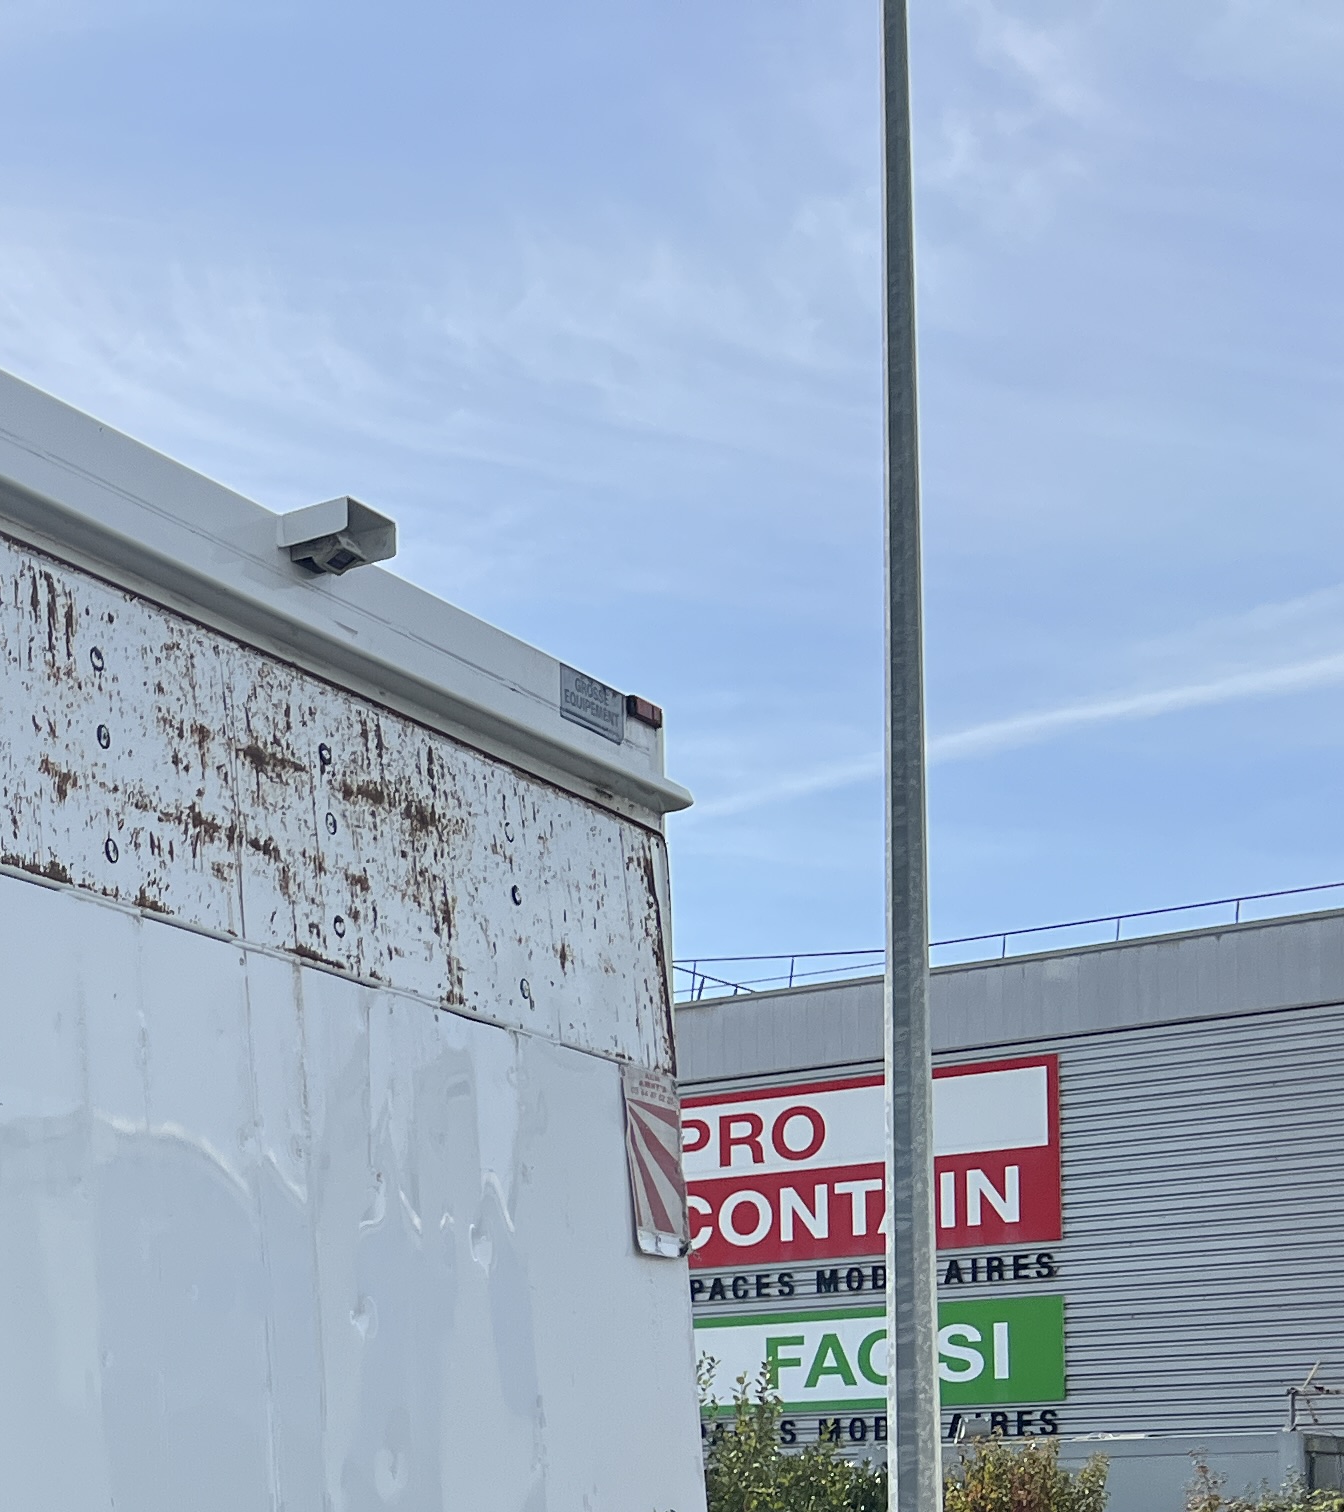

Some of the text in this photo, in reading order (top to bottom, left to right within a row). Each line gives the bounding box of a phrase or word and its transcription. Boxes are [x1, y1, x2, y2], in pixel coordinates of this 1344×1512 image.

[681, 1105, 826, 1170] PRO
[686, 1165, 1020, 1251] CONTIN
[690, 1252, 1054, 1303] PACES MODAIRES
